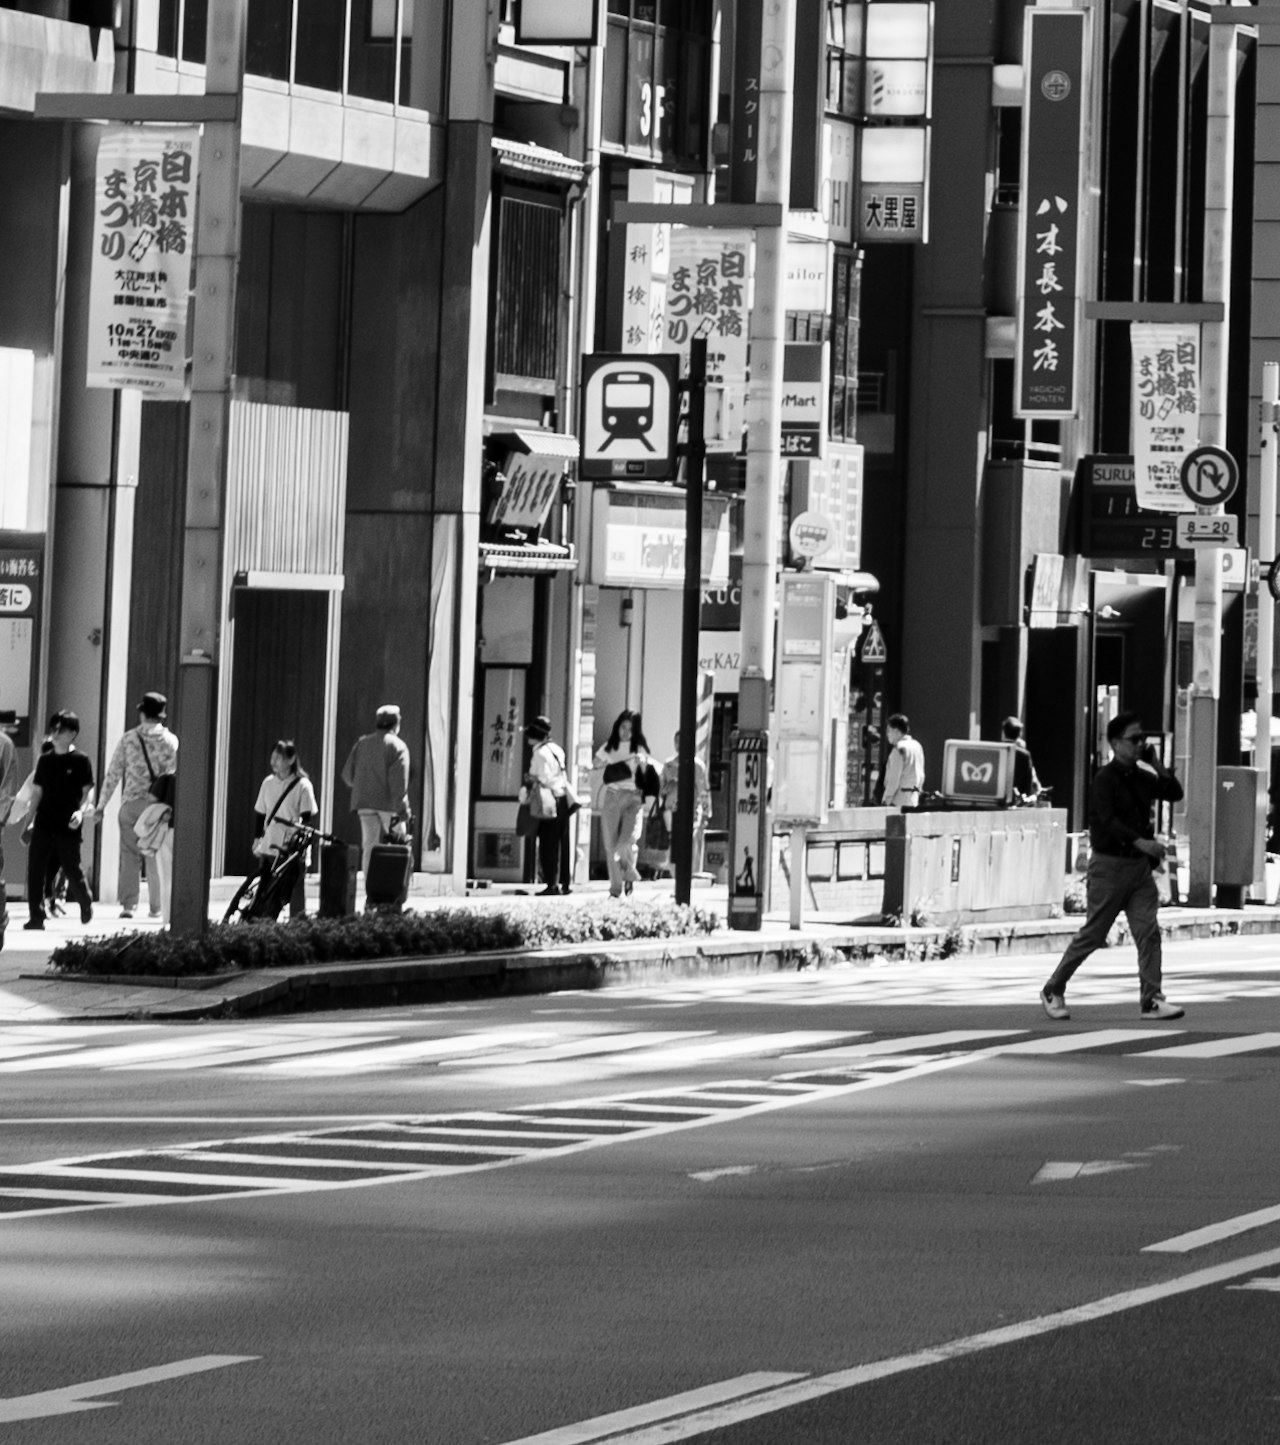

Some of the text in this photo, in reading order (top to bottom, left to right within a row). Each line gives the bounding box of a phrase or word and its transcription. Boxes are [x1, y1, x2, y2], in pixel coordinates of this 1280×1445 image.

[742, 78, 759, 163] スクール
[101, 168, 130, 261] まつり
[128, 159, 159, 228] 京橋
[156, 150, 192, 255] 日本橋
[865, 195, 917, 229] 大黒屋
[667, 266, 693, 345] まつり
[693, 258, 719, 316] 京橋
[716, 250, 745, 337] 日本橋
[1033, 195, 1069, 372] 八木長本店
[1029, 394, 1064, 403] HONTEN
[1138, 356, 1155, 420] まつり
[1155, 348, 1177, 397] 京橋
[1175, 340, 1197, 414] 日本橋
[1142, 528, 1173, 549] 23
[745, 753, 759, 789] 50
